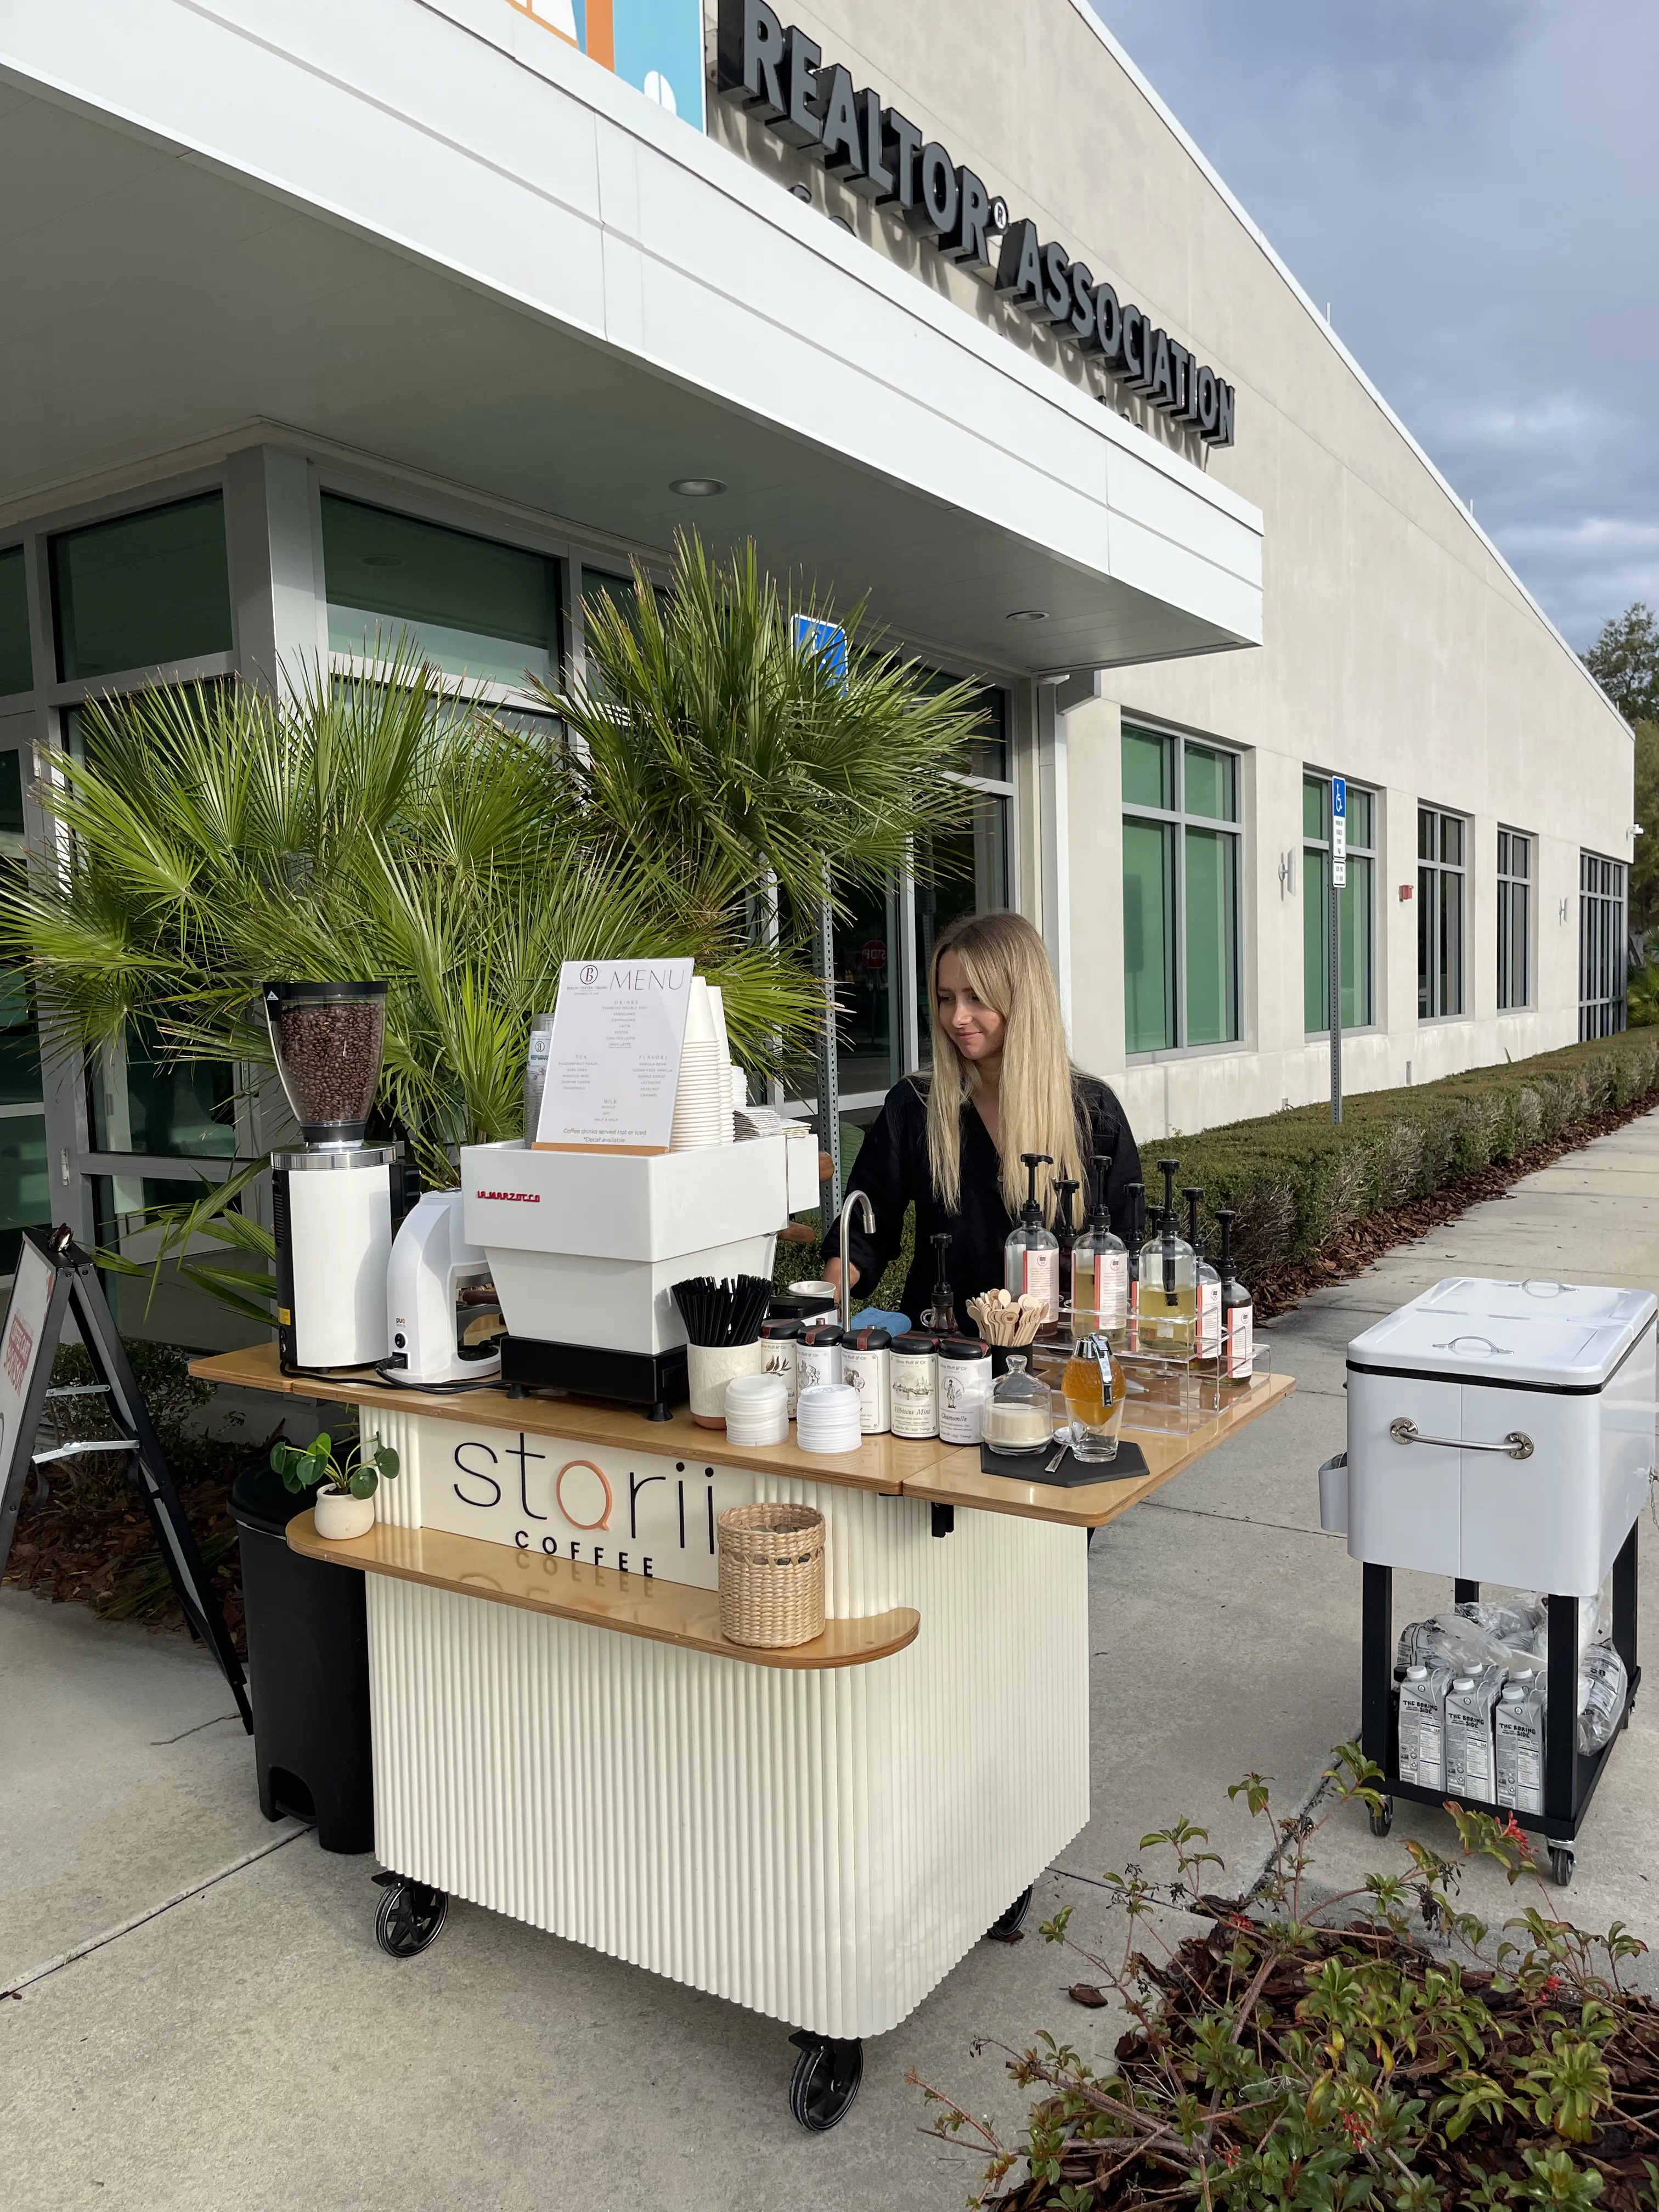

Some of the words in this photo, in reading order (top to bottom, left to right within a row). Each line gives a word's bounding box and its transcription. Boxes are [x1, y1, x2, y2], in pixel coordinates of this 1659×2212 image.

[996, 218, 1234, 449] ASSOCIATION
[610, 969, 685, 990] MENU
[477, 1190, 486, 1199] LA
[489, 1191, 540, 1203] MARZOCCO
[894, 1406, 915, 1415] Hibiscus
[941, 1412, 968, 1422] Chamomile
[515, 1530, 653, 1577] COFFEE
[1417, 1702, 1438, 1711] BORING
[1463, 1715, 1485, 1725] BORING
[1514, 1725, 1536, 1735] BORING
